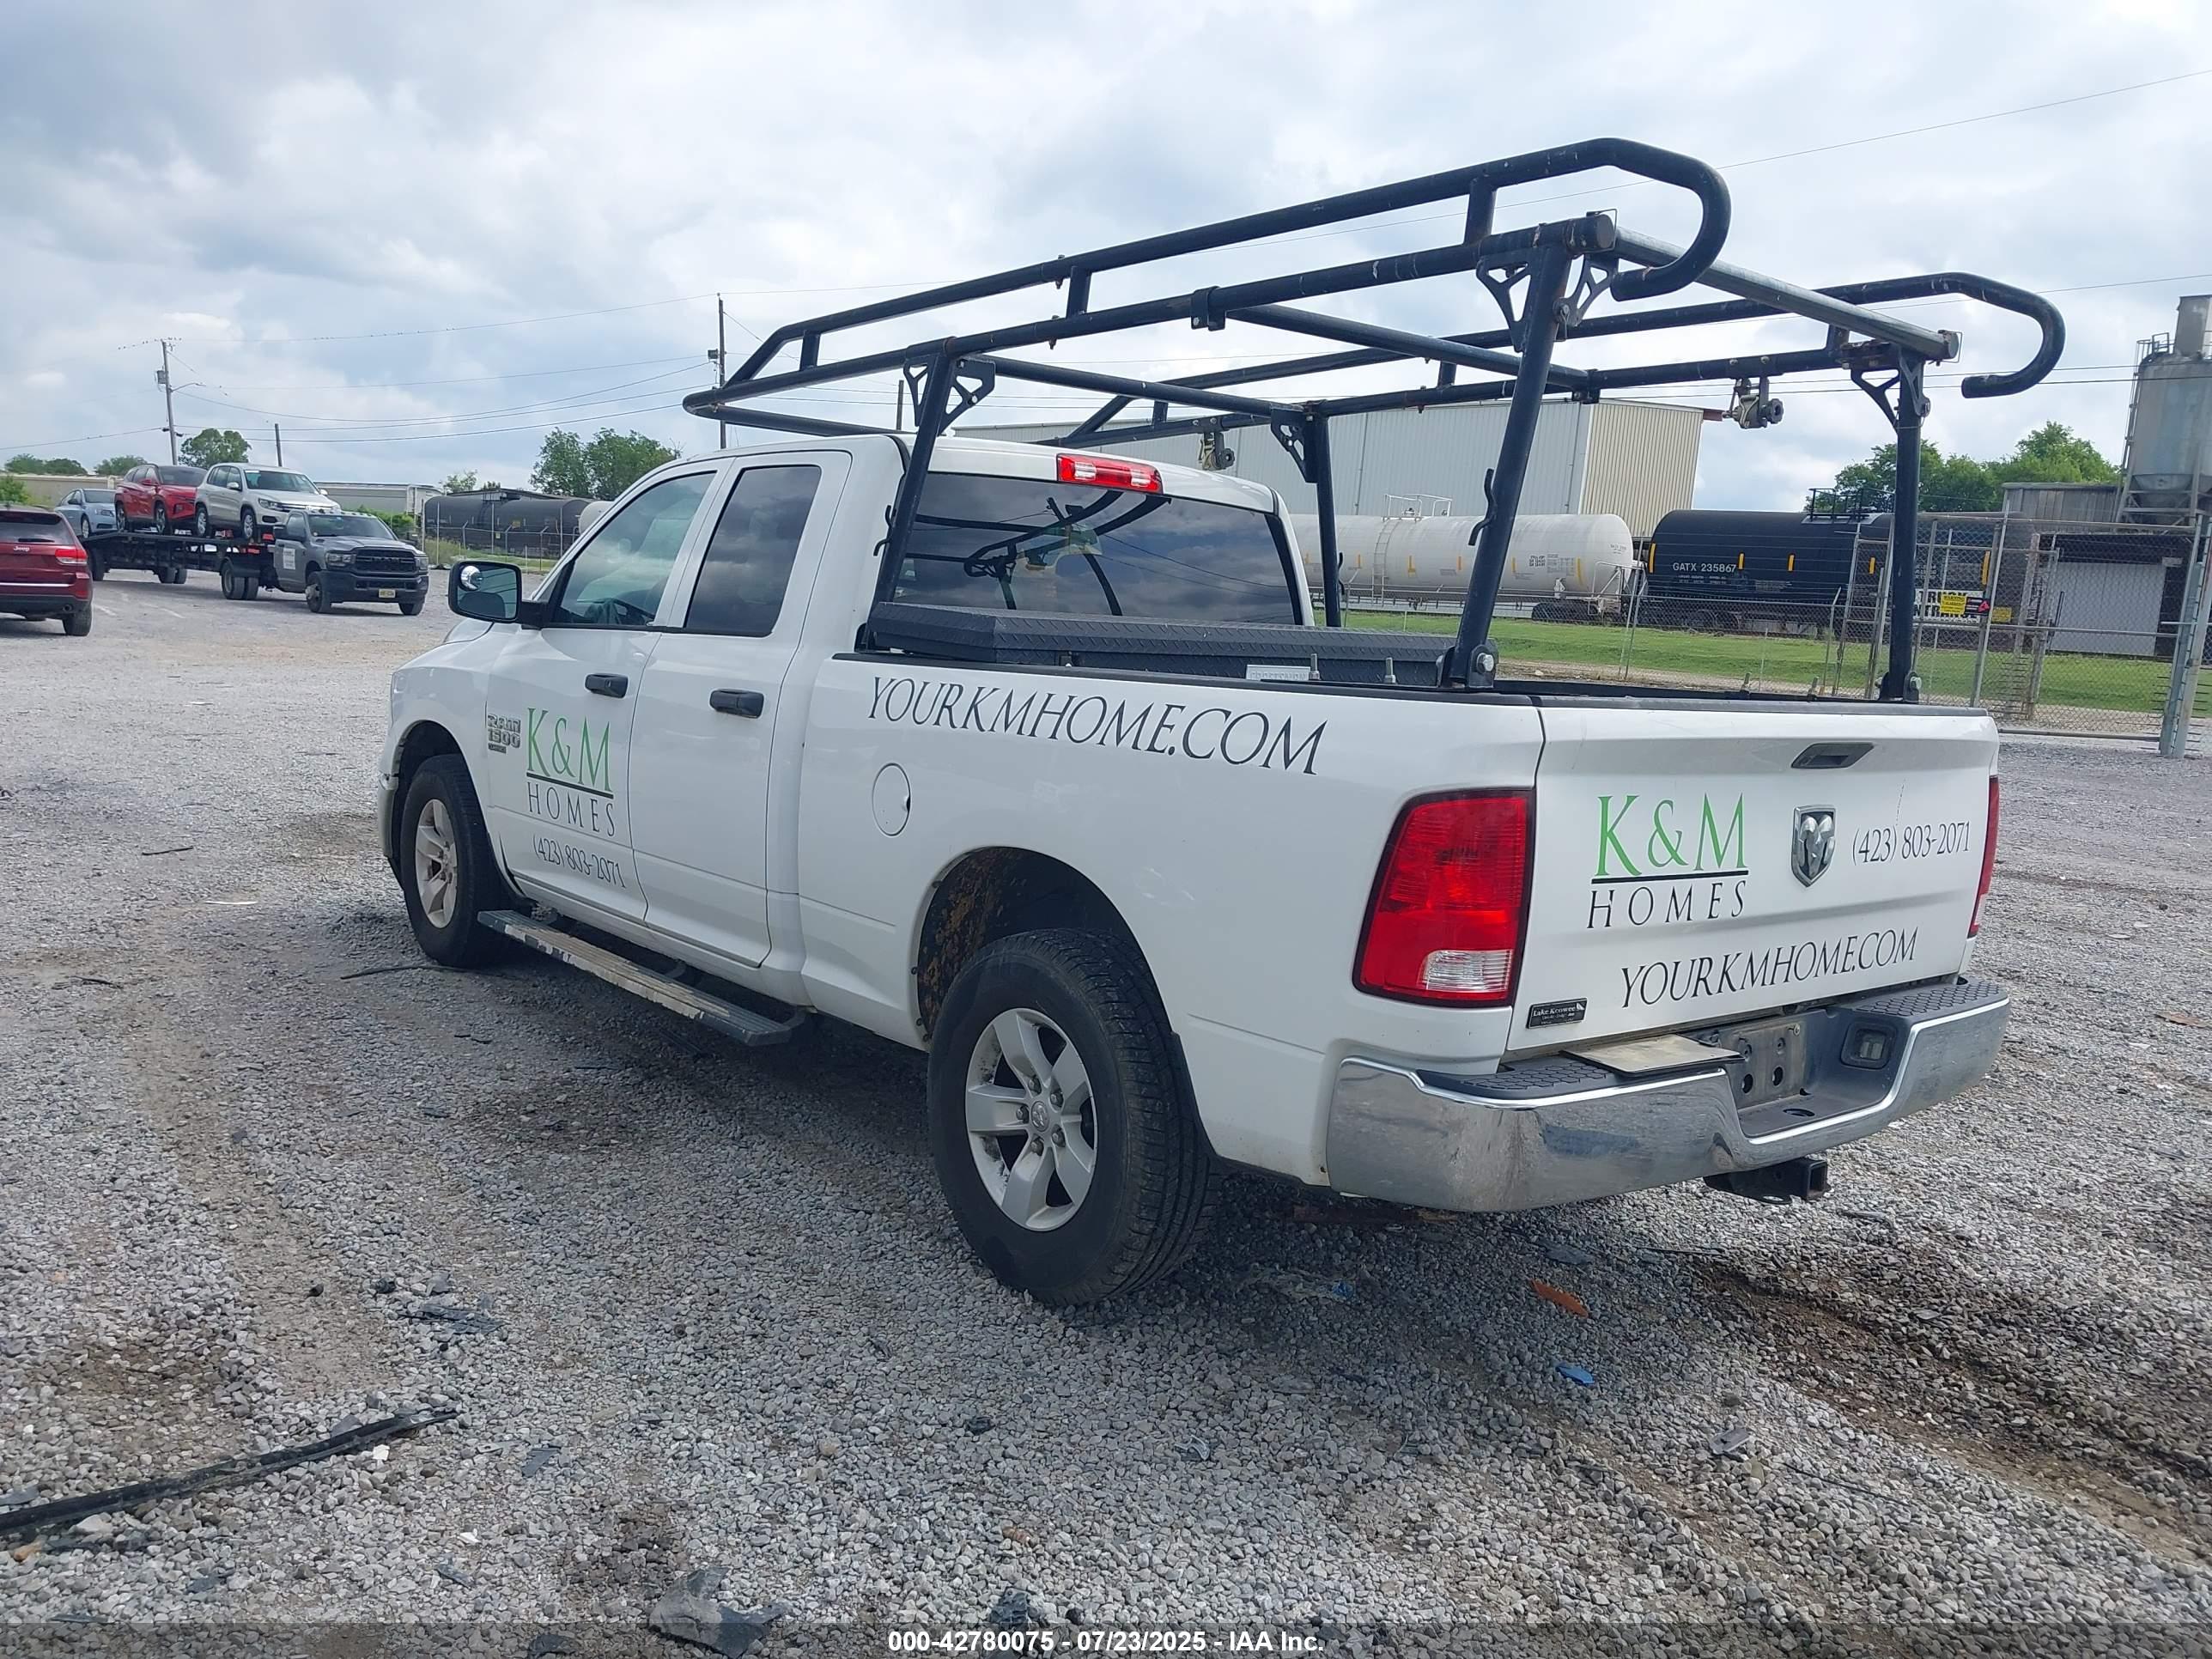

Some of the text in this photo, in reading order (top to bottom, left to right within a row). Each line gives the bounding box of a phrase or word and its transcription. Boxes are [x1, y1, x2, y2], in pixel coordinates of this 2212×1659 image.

[1672, 562, 1736, 573] GATX 235867
[526, 707, 612, 793] K&M
[868, 676, 1328, 775] YOURKMHOME.COM
[526, 781, 614, 837] HOMES
[1594, 792, 1748, 878] K&M
[532, 834, 626, 889] (423) 803-2071
[1852, 821, 1971, 866] (423) 803-2071
[1587, 879, 1747, 929] HOMES
[1621, 926, 1919, 1009] YOURKMHOME.COM
[1533, 1008, 1548, 1017] Lake
